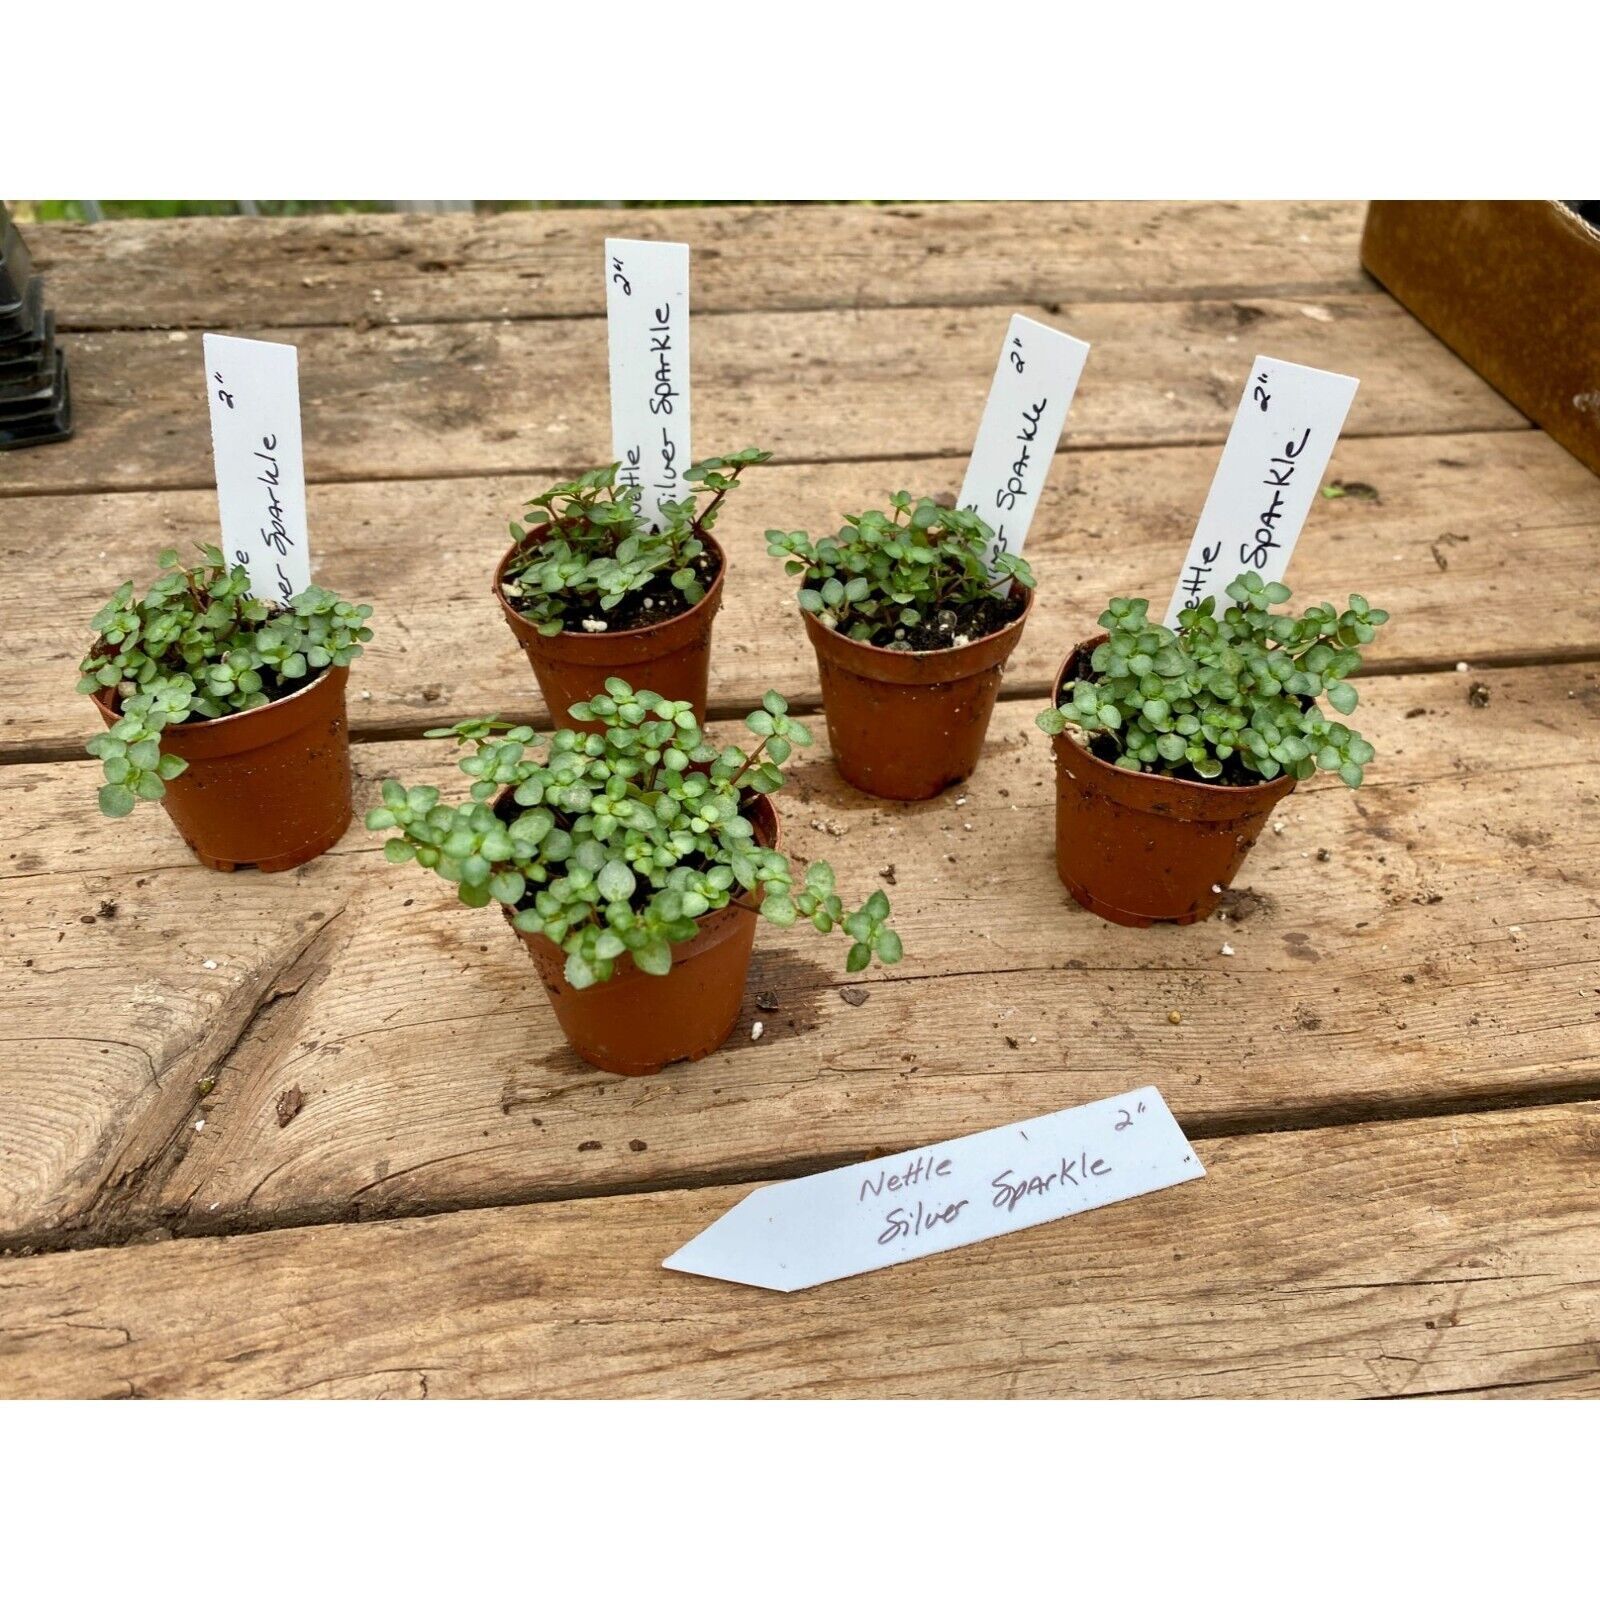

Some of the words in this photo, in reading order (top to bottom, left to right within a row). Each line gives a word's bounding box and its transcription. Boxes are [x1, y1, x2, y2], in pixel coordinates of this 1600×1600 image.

[1174, 541, 1222, 632] ettle
[859, 1155, 953, 1202] Nettle
[1113, 1102, 1147, 1132] 2"
[877, 1198, 970, 1245] Silver
